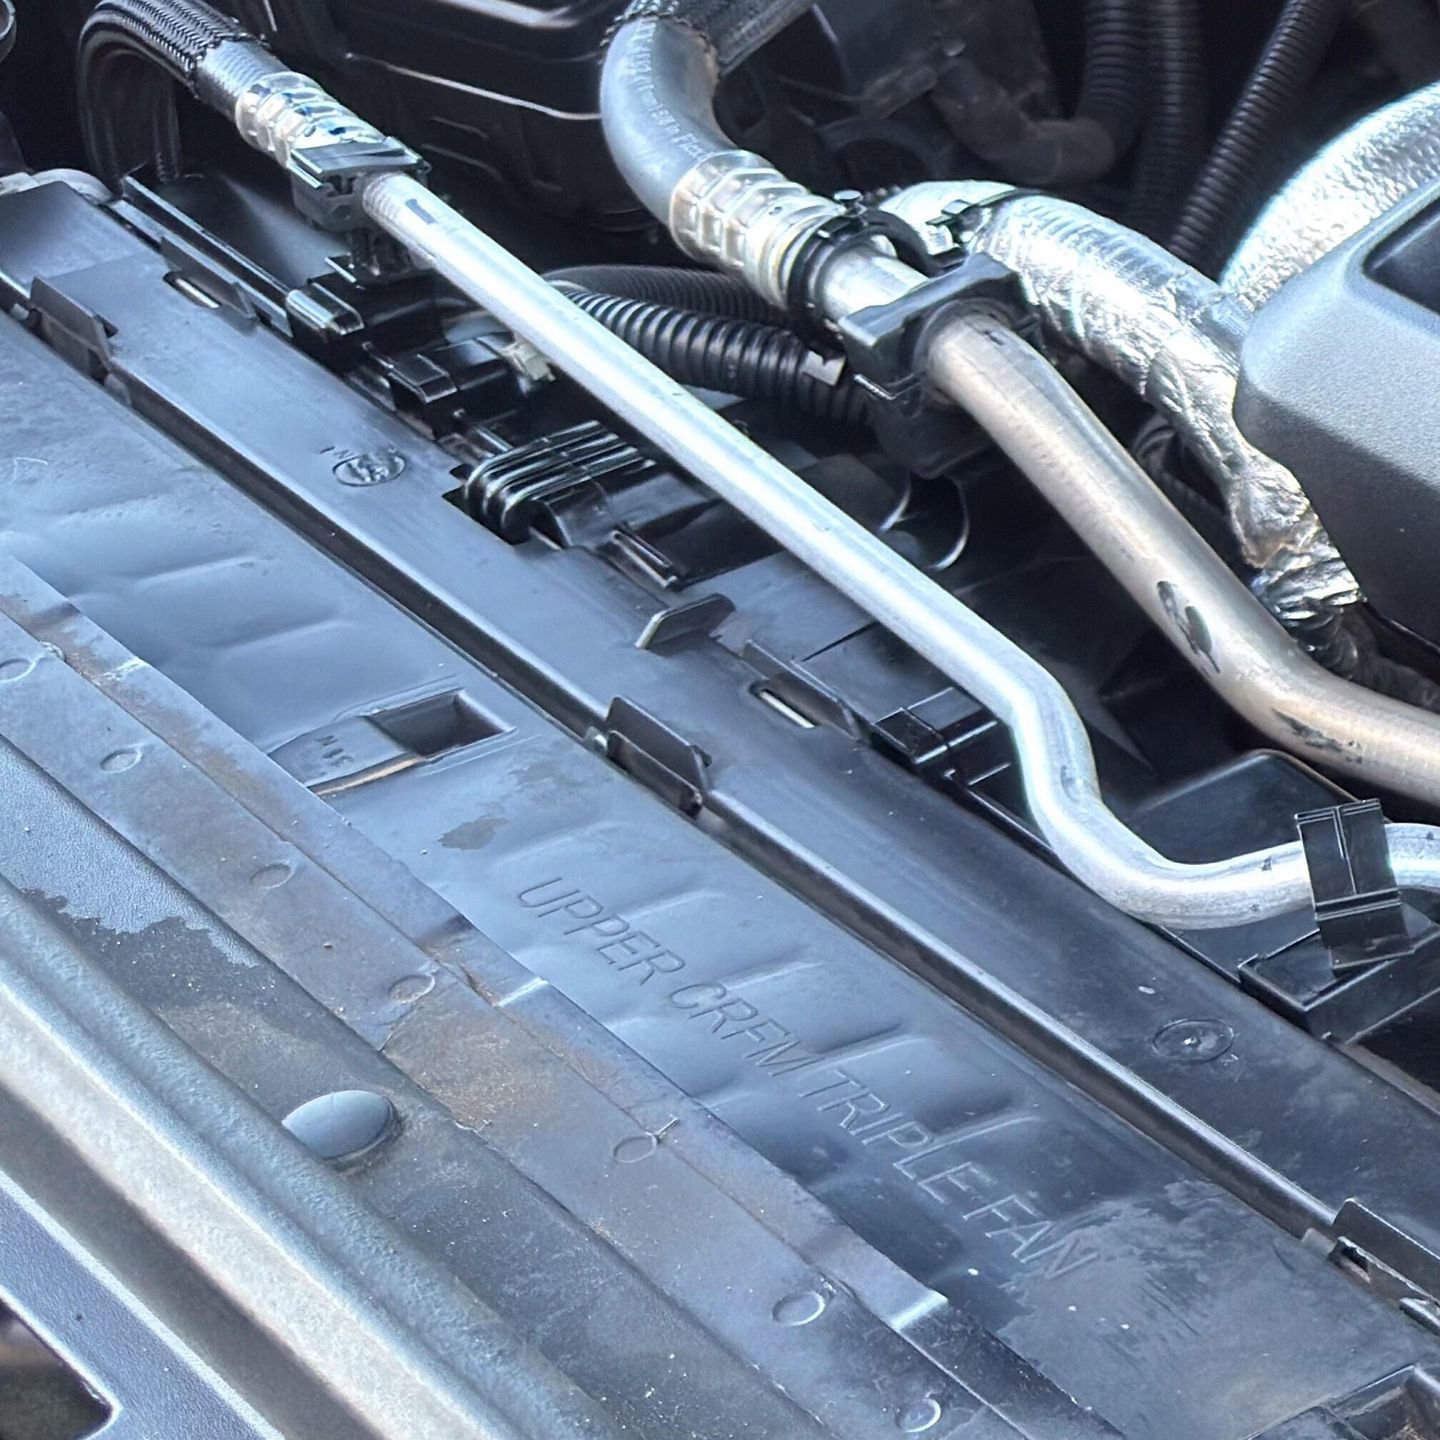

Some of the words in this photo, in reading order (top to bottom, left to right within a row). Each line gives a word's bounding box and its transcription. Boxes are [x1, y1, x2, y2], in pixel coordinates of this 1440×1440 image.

[515, 876, 688, 987] UPPER
[809, 1070, 997, 1205] TRIPLE
[962, 1188, 1102, 1279] FAN
